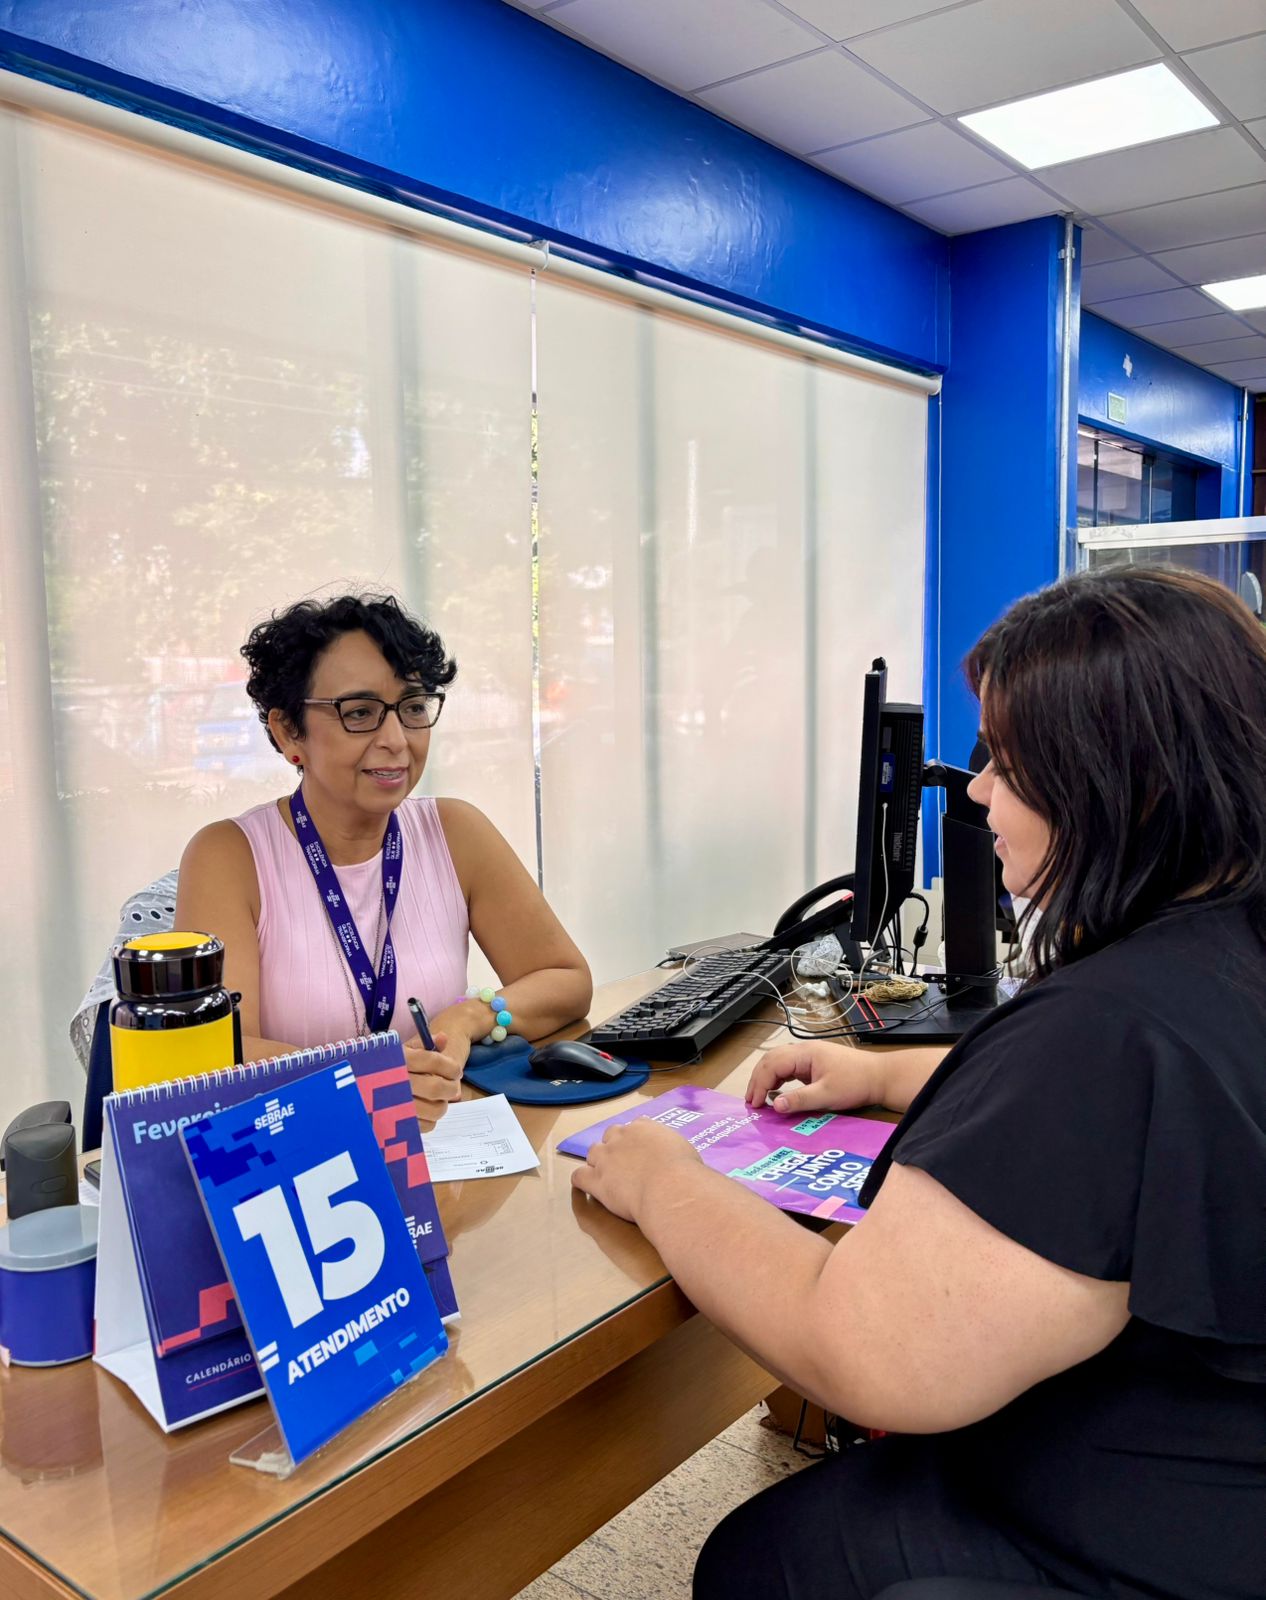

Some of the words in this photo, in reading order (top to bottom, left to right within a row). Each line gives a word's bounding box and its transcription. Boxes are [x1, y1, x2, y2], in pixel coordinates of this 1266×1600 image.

[254, 1102, 296, 1130] SEBRAE
[687, 1119, 729, 1144] omeçando
[757, 1153, 817, 1181] CHEGA
[790, 1149, 845, 1180] JUNTO
[808, 1169, 849, 1191] COM
[840, 1162, 863, 1173] O
[232, 1150, 386, 1330] 15
[408, 1221, 433, 1238] RAE
[287, 1287, 411, 1386] ATENDIMENTO
[185, 1353, 252, 1384] CALENDÁRIO
